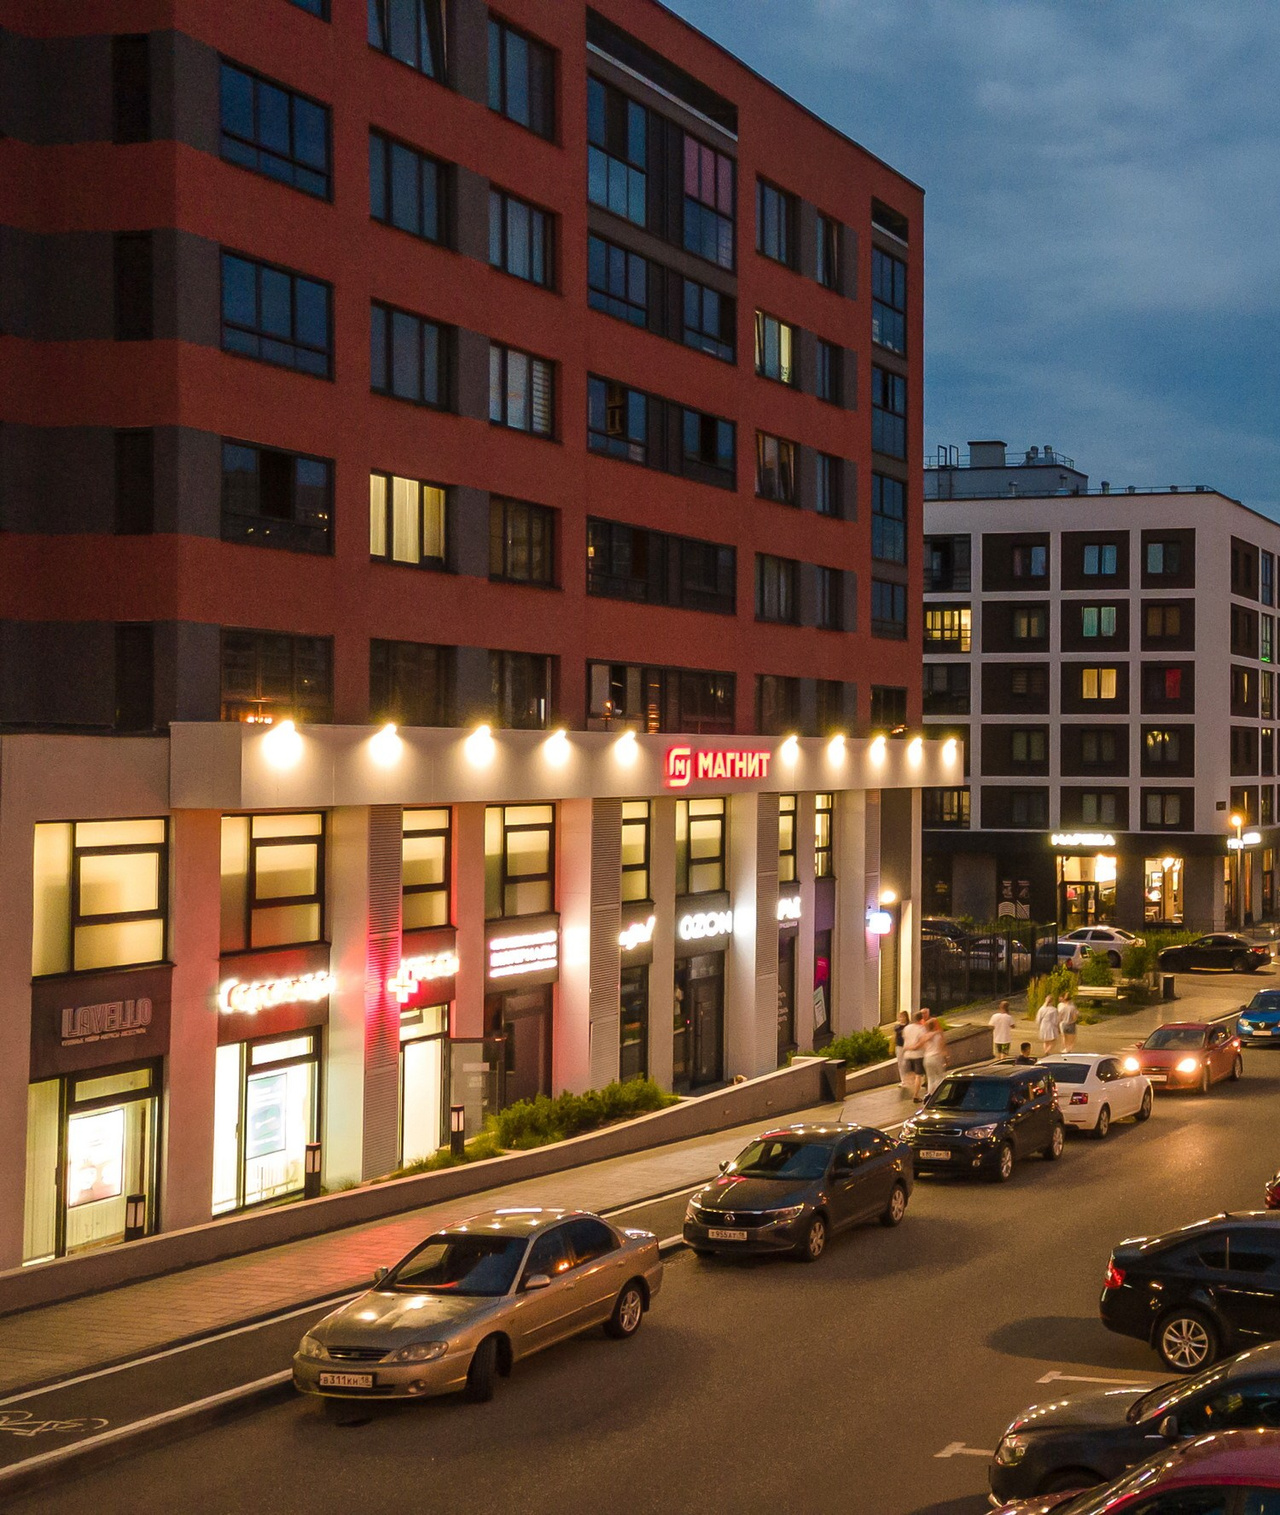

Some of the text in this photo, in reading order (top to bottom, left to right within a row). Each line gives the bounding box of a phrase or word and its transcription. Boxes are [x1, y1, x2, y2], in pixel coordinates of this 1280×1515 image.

[698, 751, 771, 778] МАГНИТ
[679, 910, 733, 941] OZON
[61, 998, 152, 1038] LAVELLO
